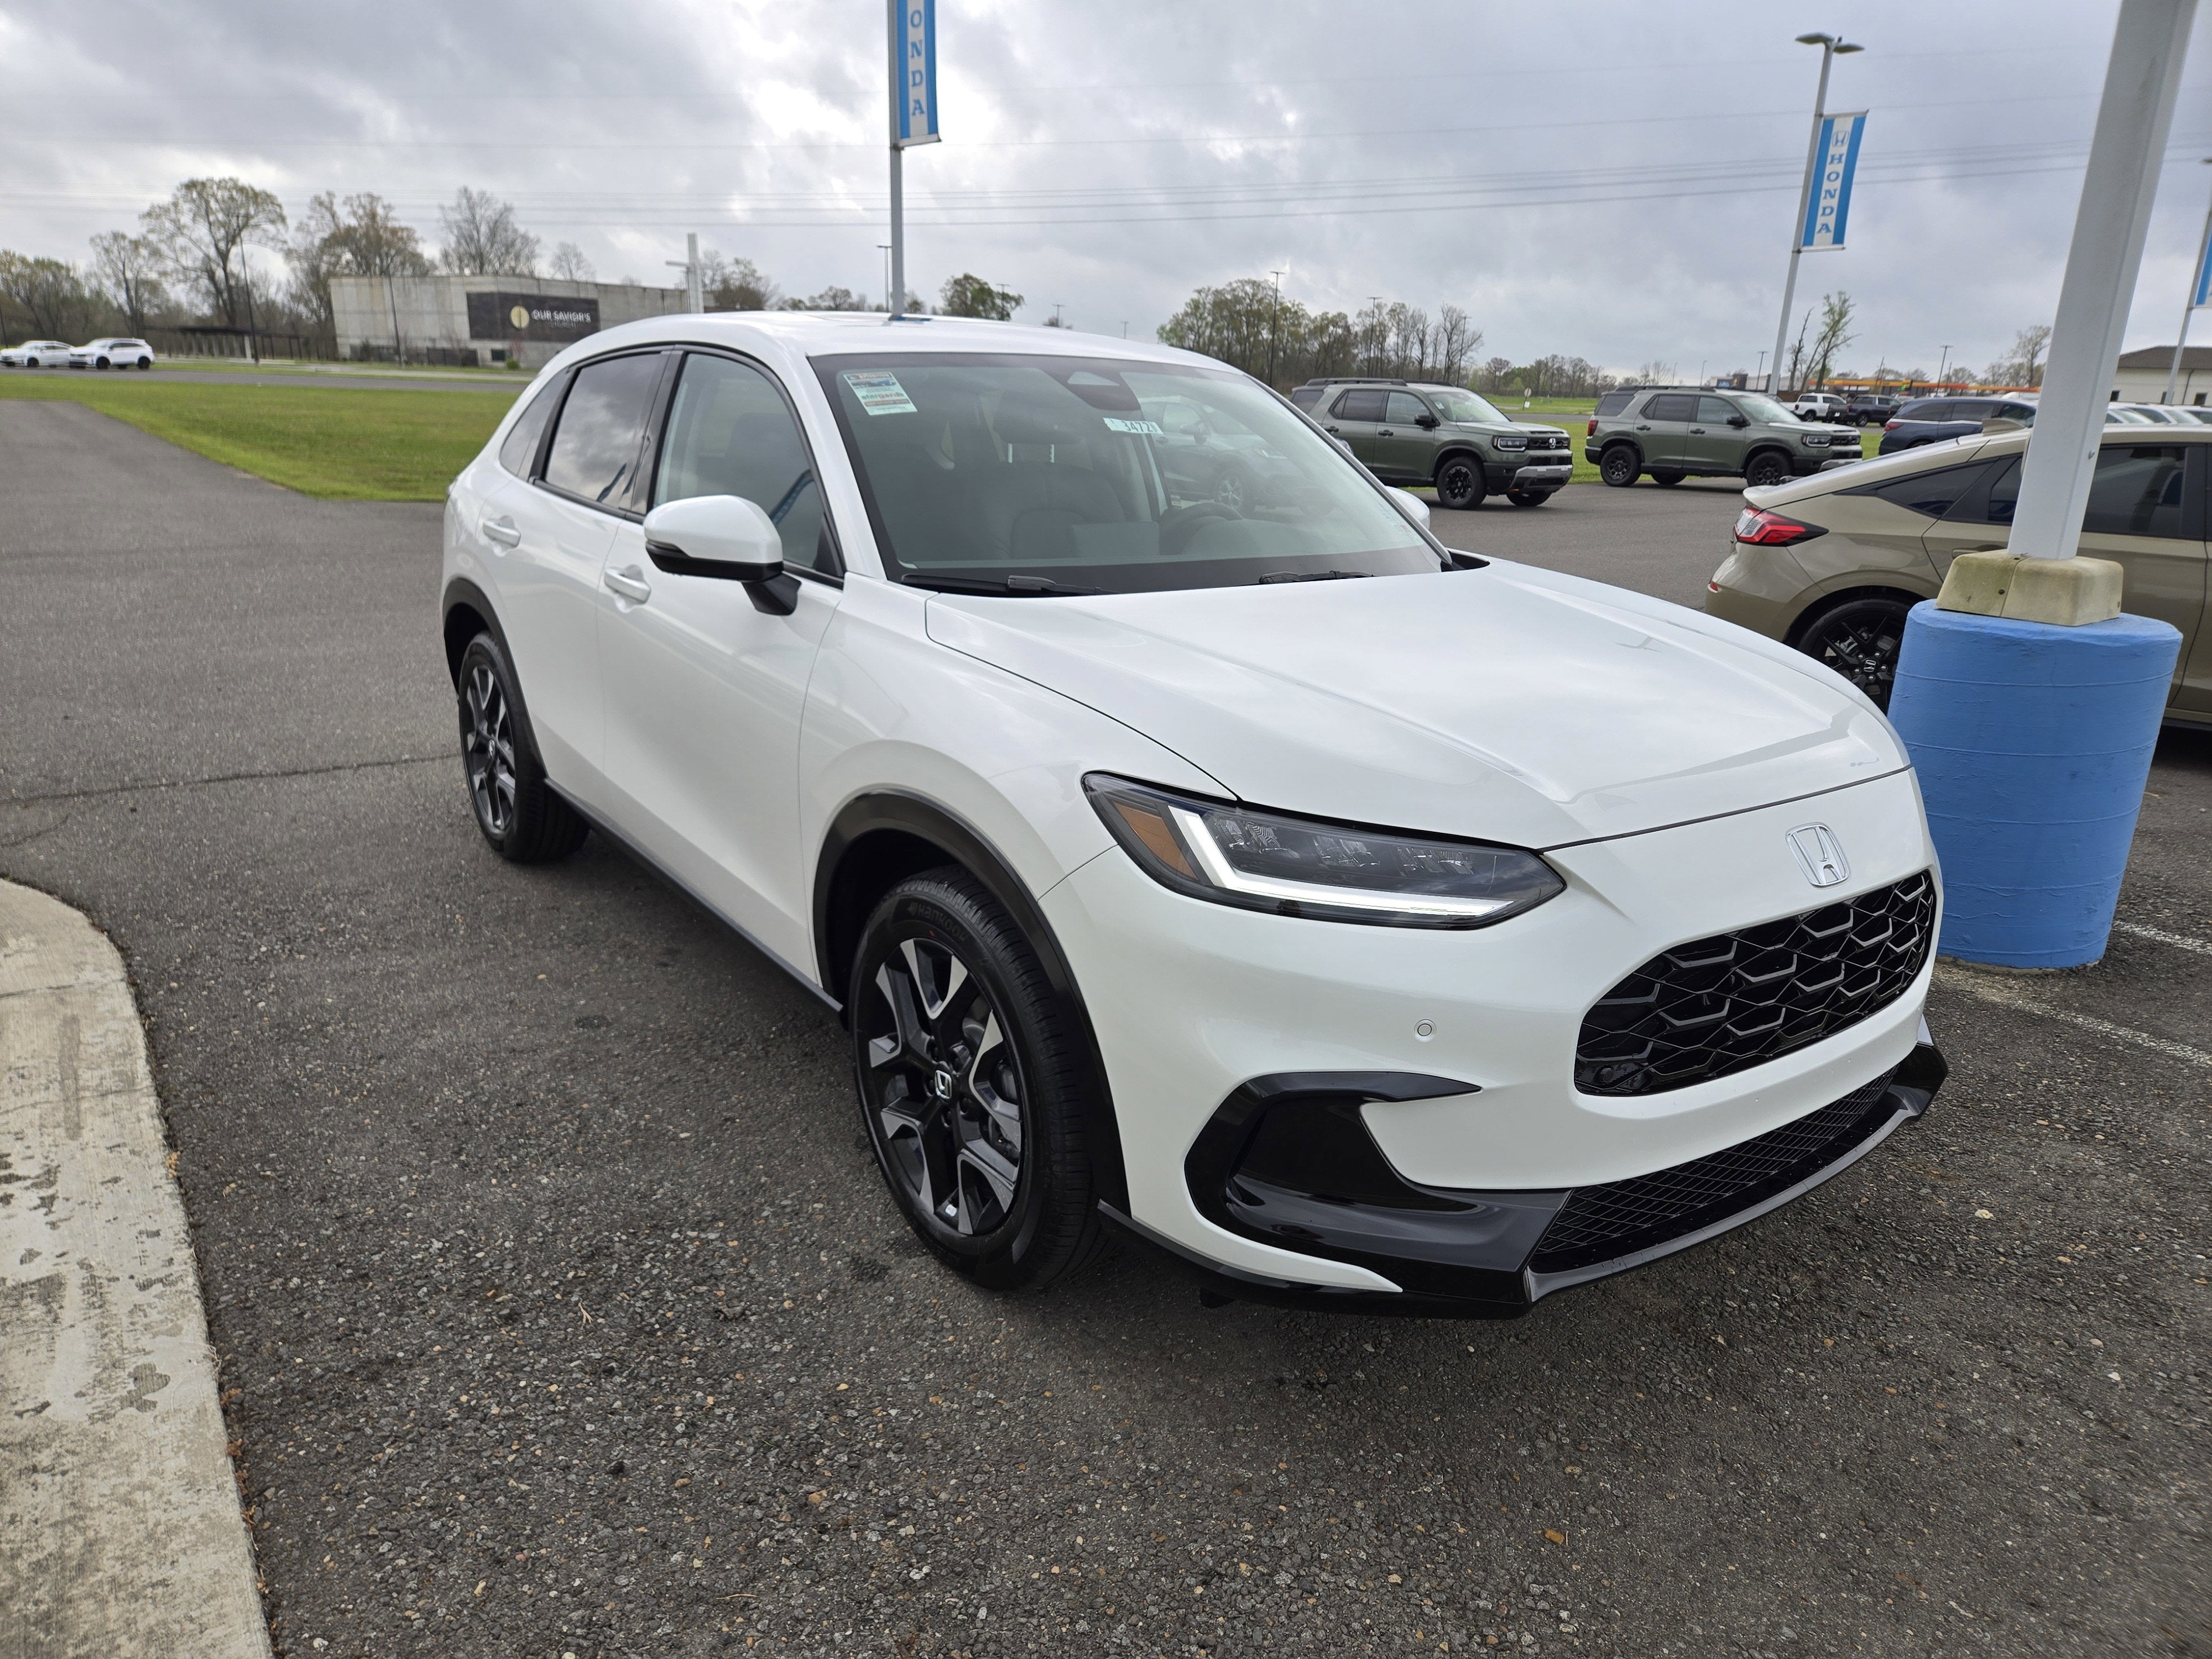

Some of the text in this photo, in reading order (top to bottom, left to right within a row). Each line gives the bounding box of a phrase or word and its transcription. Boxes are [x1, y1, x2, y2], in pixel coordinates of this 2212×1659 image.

[1817, 153, 1844, 234] HONDA
[532, 309, 591, 323] OUR SAVIOR'S
